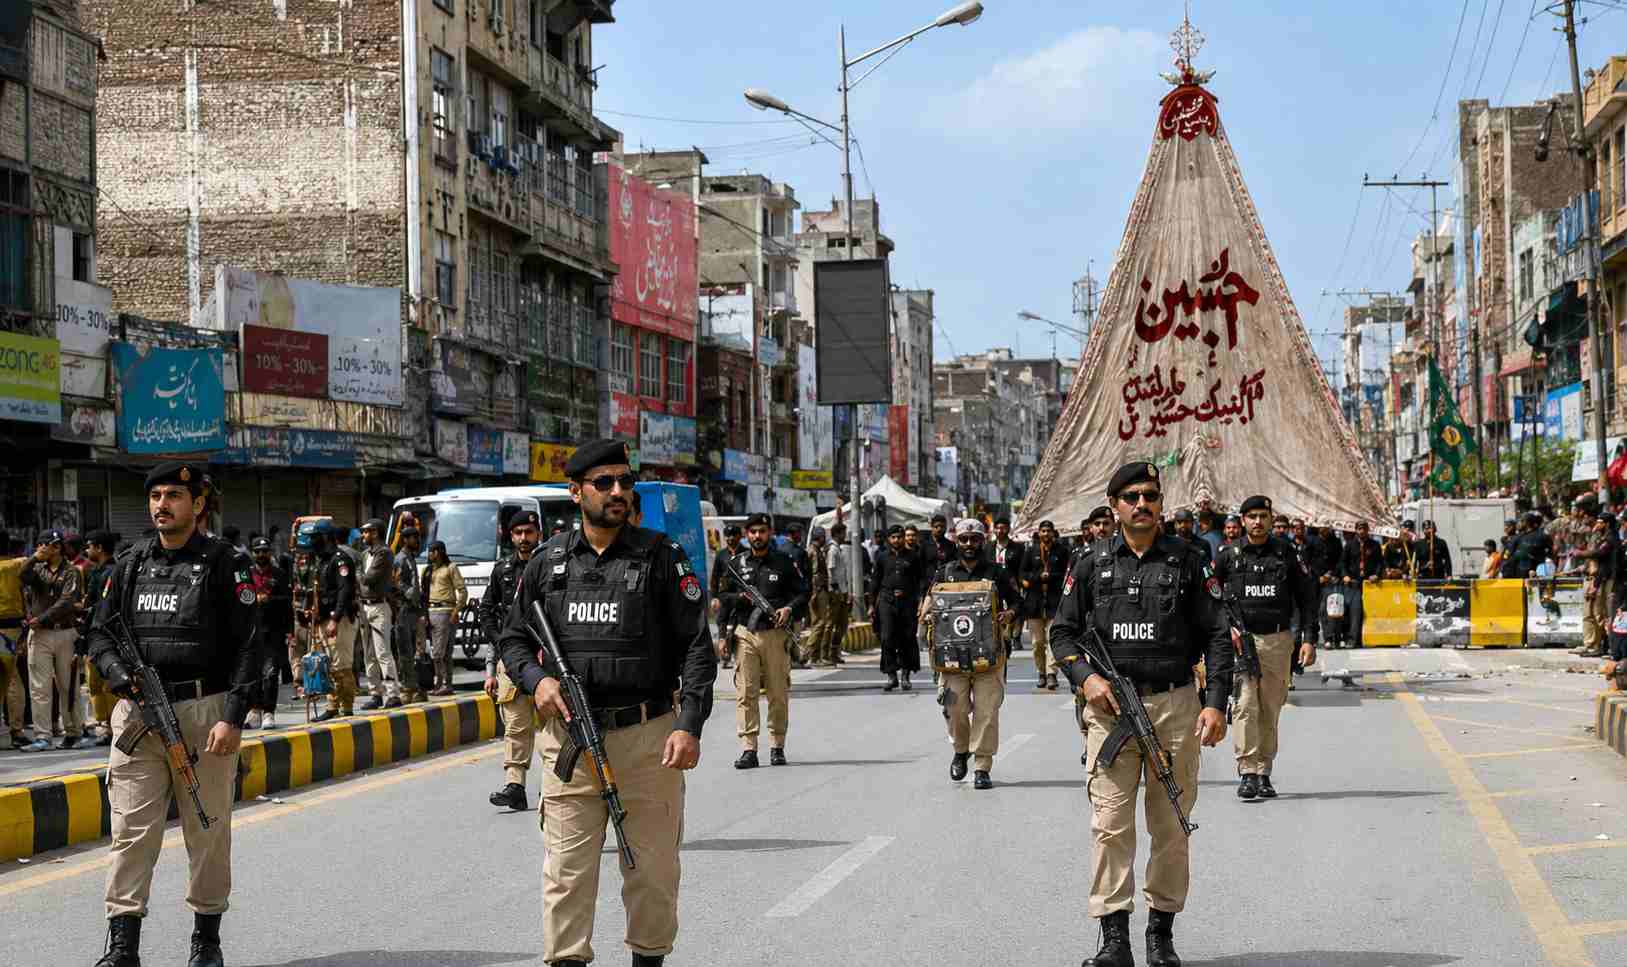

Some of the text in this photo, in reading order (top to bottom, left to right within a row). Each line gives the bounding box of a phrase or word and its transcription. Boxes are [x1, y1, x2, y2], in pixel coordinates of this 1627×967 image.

[1245, 584, 1276, 597] POLICE
[137, 593, 179, 612] POLICE
[568, 602, 618, 623] POLICE
[1112, 623, 1154, 640] POLICE
